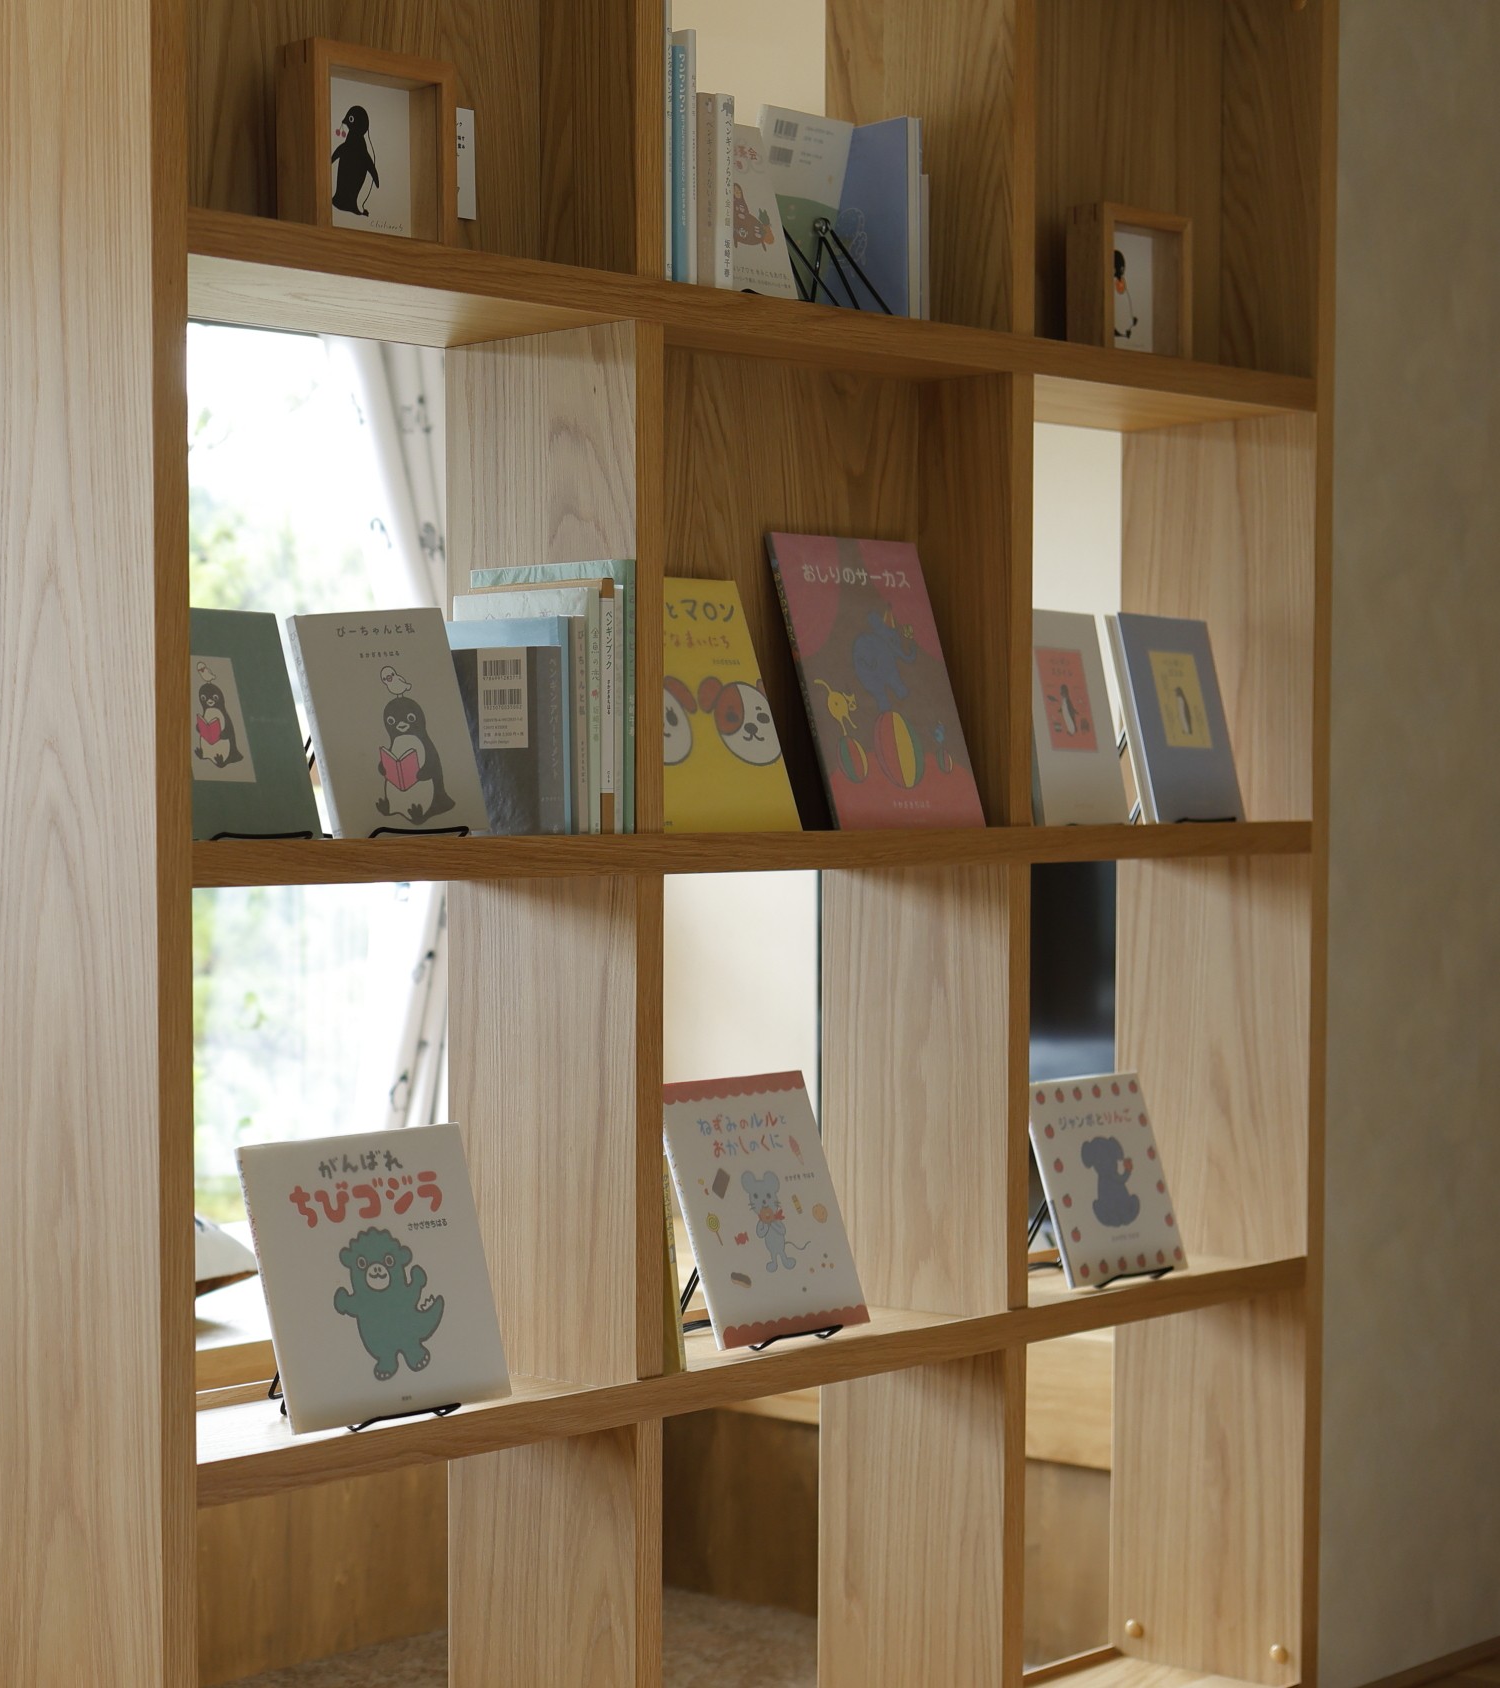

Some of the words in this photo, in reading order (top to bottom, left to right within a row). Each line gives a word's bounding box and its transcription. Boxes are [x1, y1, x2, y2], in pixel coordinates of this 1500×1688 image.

[802, 564, 911, 589] おしりのサーカス
[665, 599, 735, 622] とマロン
[605, 611, 613, 670] ペンギンブック
[664, 630, 730, 648] なまいにち
[697, 1111, 787, 1137] ねずみのルルと
[713, 1134, 784, 1159] おかしのくに
[318, 1150, 403, 1179] がんばれ
[289, 1171, 443, 1228] ちびゴジラ
